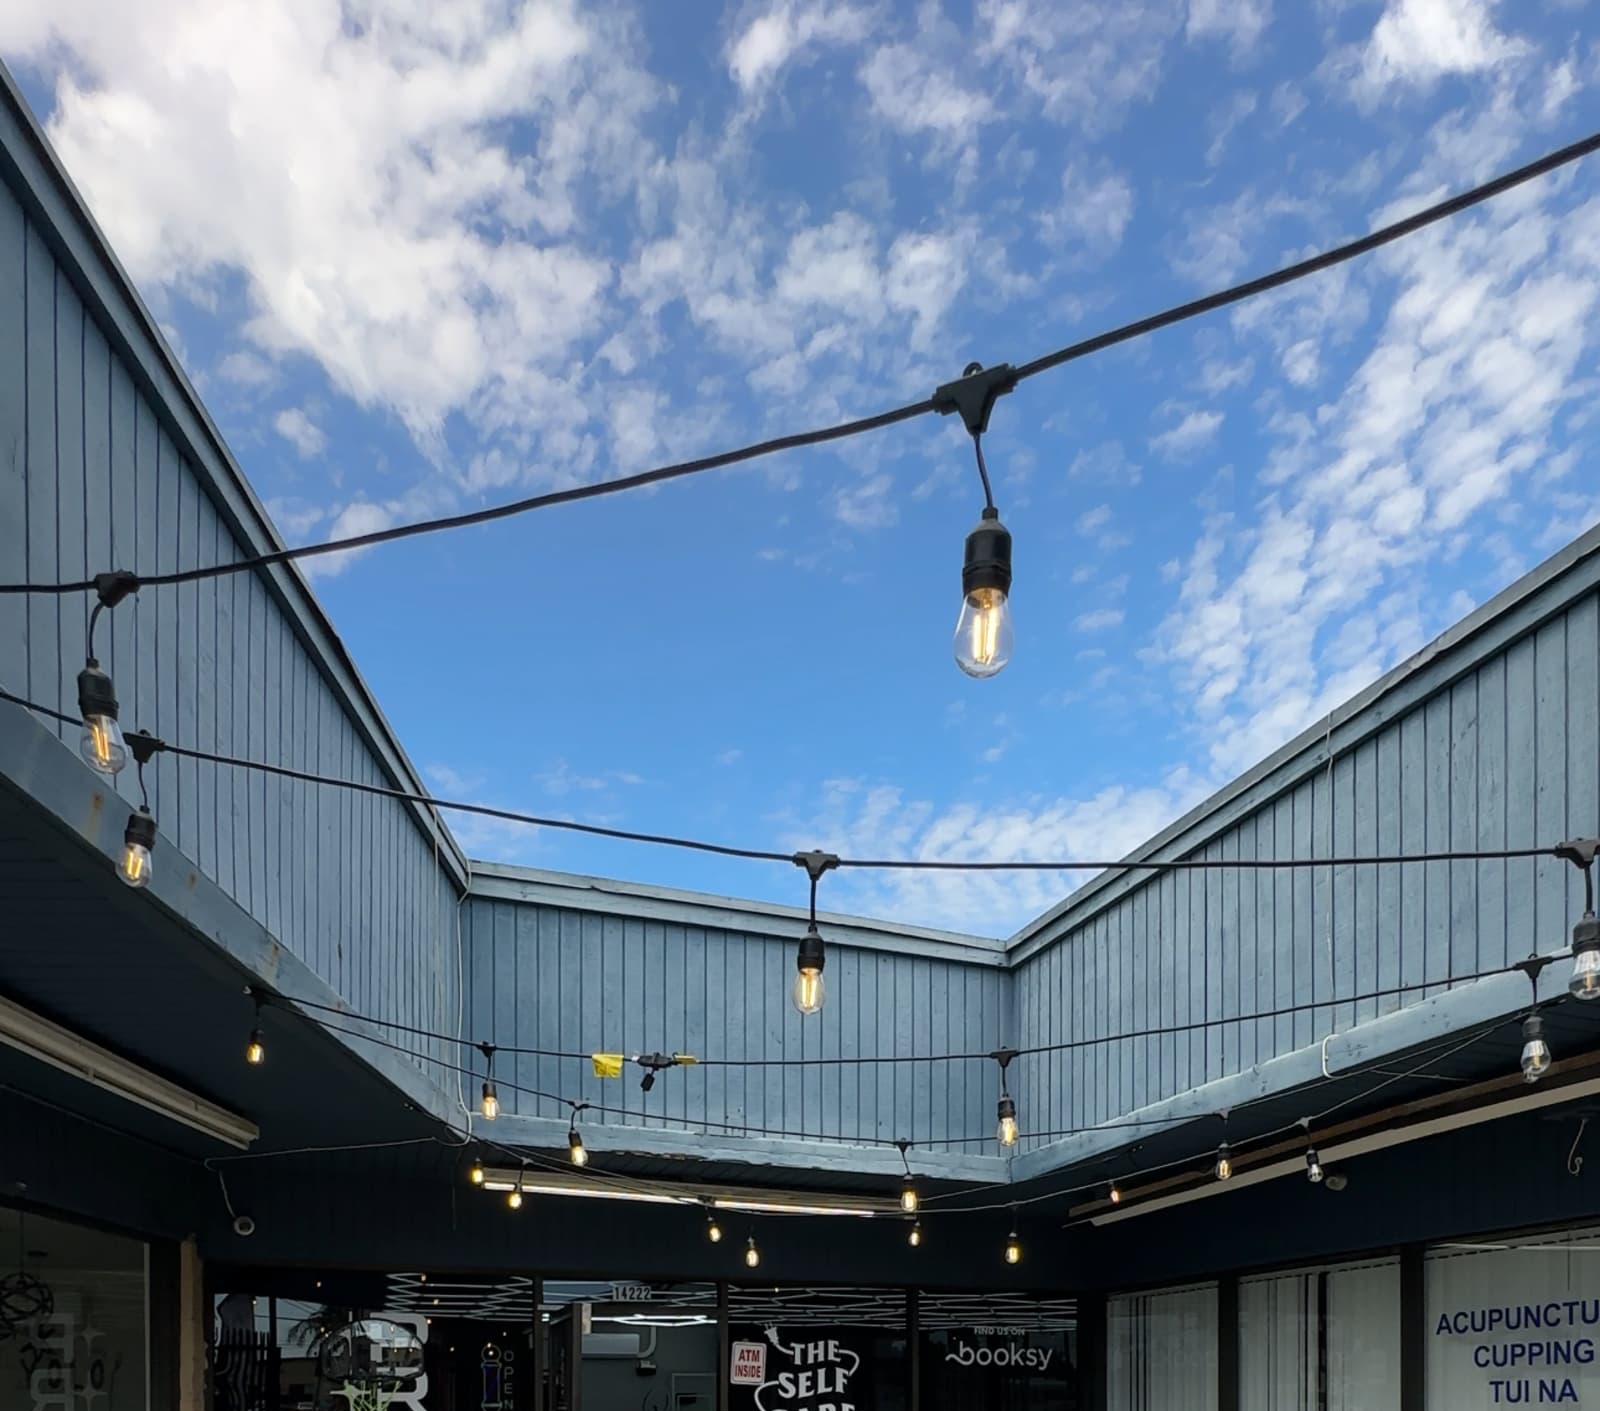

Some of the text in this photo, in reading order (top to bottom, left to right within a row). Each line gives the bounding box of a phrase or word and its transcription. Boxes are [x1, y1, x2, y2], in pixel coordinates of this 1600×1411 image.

[615, 1286, 650, 1300] 14222
[1436, 1299, 1600, 1335] ACUPUNCTU
[974, 1326, 994, 1335] FIND
[997, 1326, 1009, 1335] US
[738, 1349, 760, 1362] ATM
[790, 1340, 841, 1365] THE
[945, 1340, 1053, 1370] booksy
[1474, 1339, 1595, 1367] CUPPING
[503, 1350, 514, 1410] OPEN
[735, 1365, 761, 1378] INSIDE
[777, 1367, 849, 1399] SELF
[1489, 1379, 1578, 1403] TUI NA
